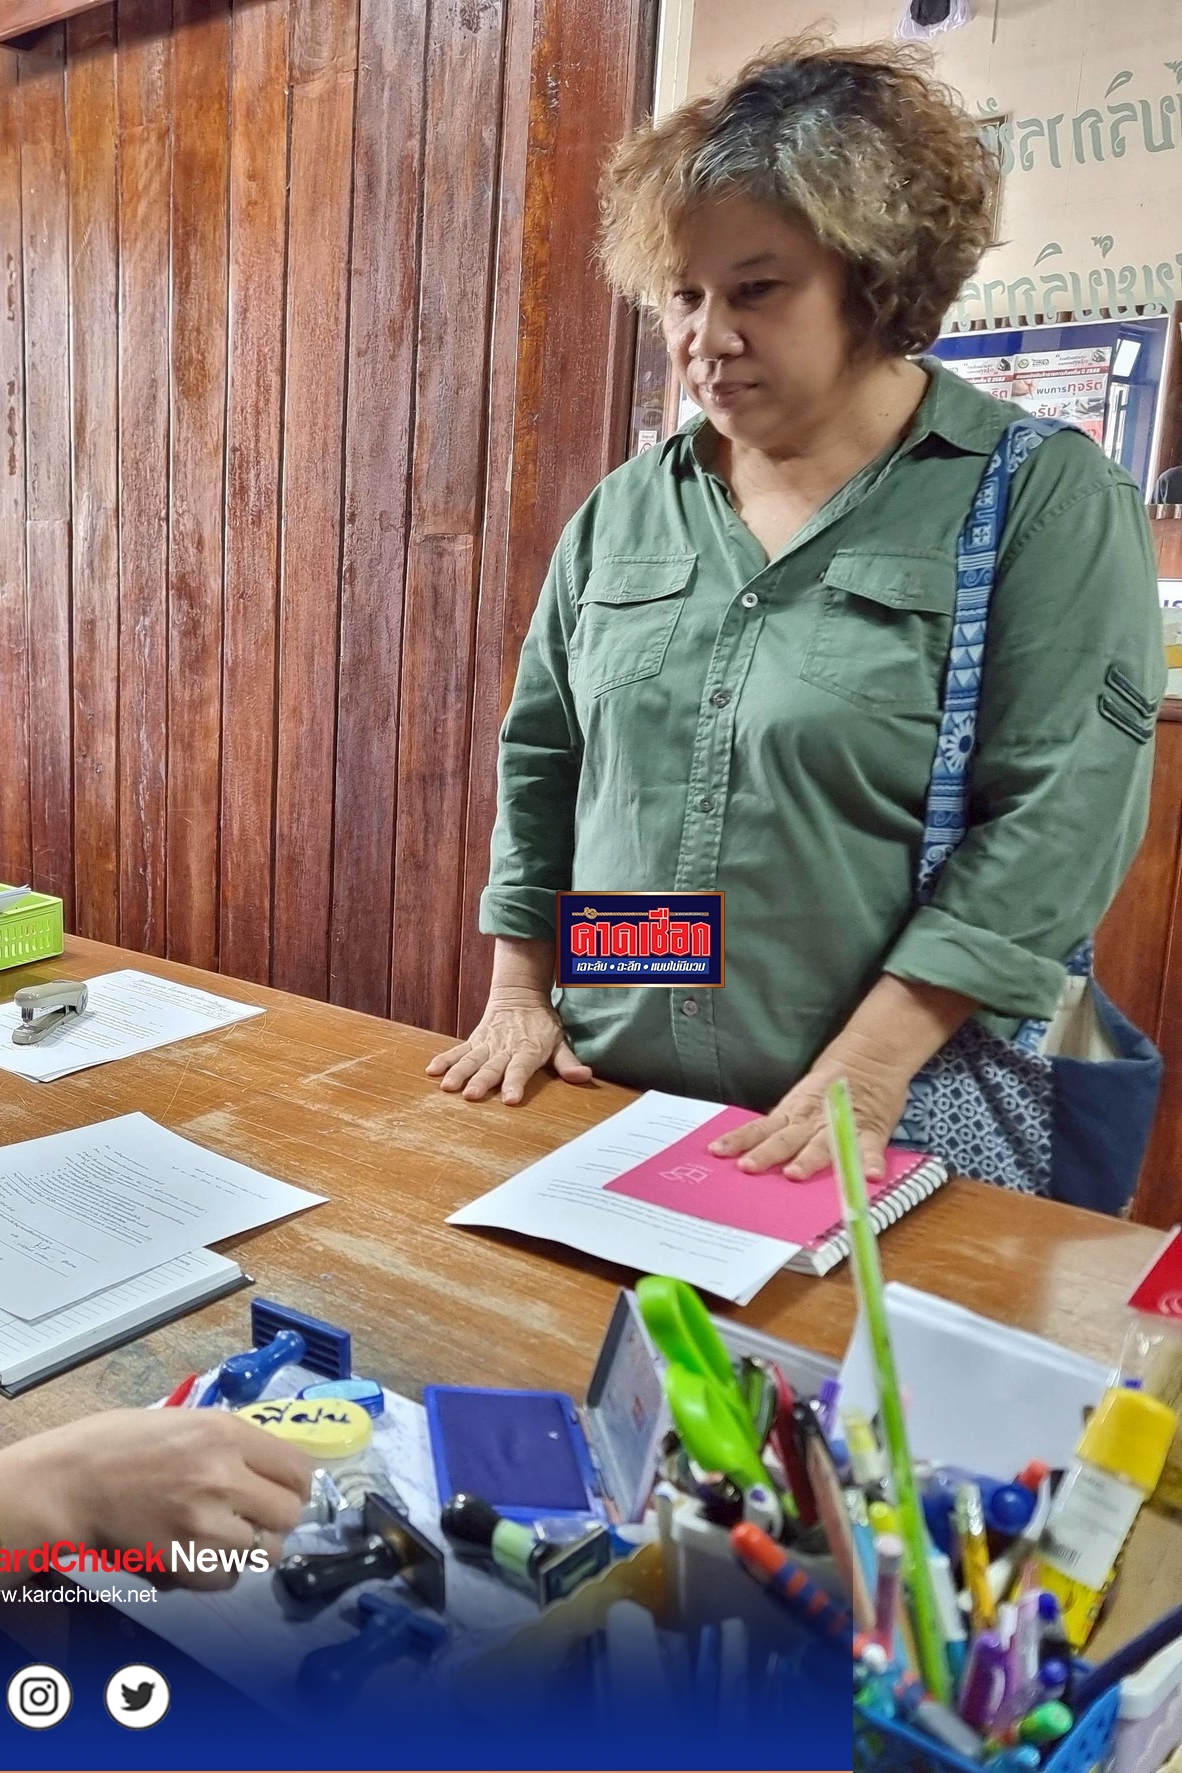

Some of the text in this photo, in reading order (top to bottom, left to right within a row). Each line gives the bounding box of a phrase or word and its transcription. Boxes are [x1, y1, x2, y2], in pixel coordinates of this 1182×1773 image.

[1036, 379, 1103, 396] พบการทุจริต
